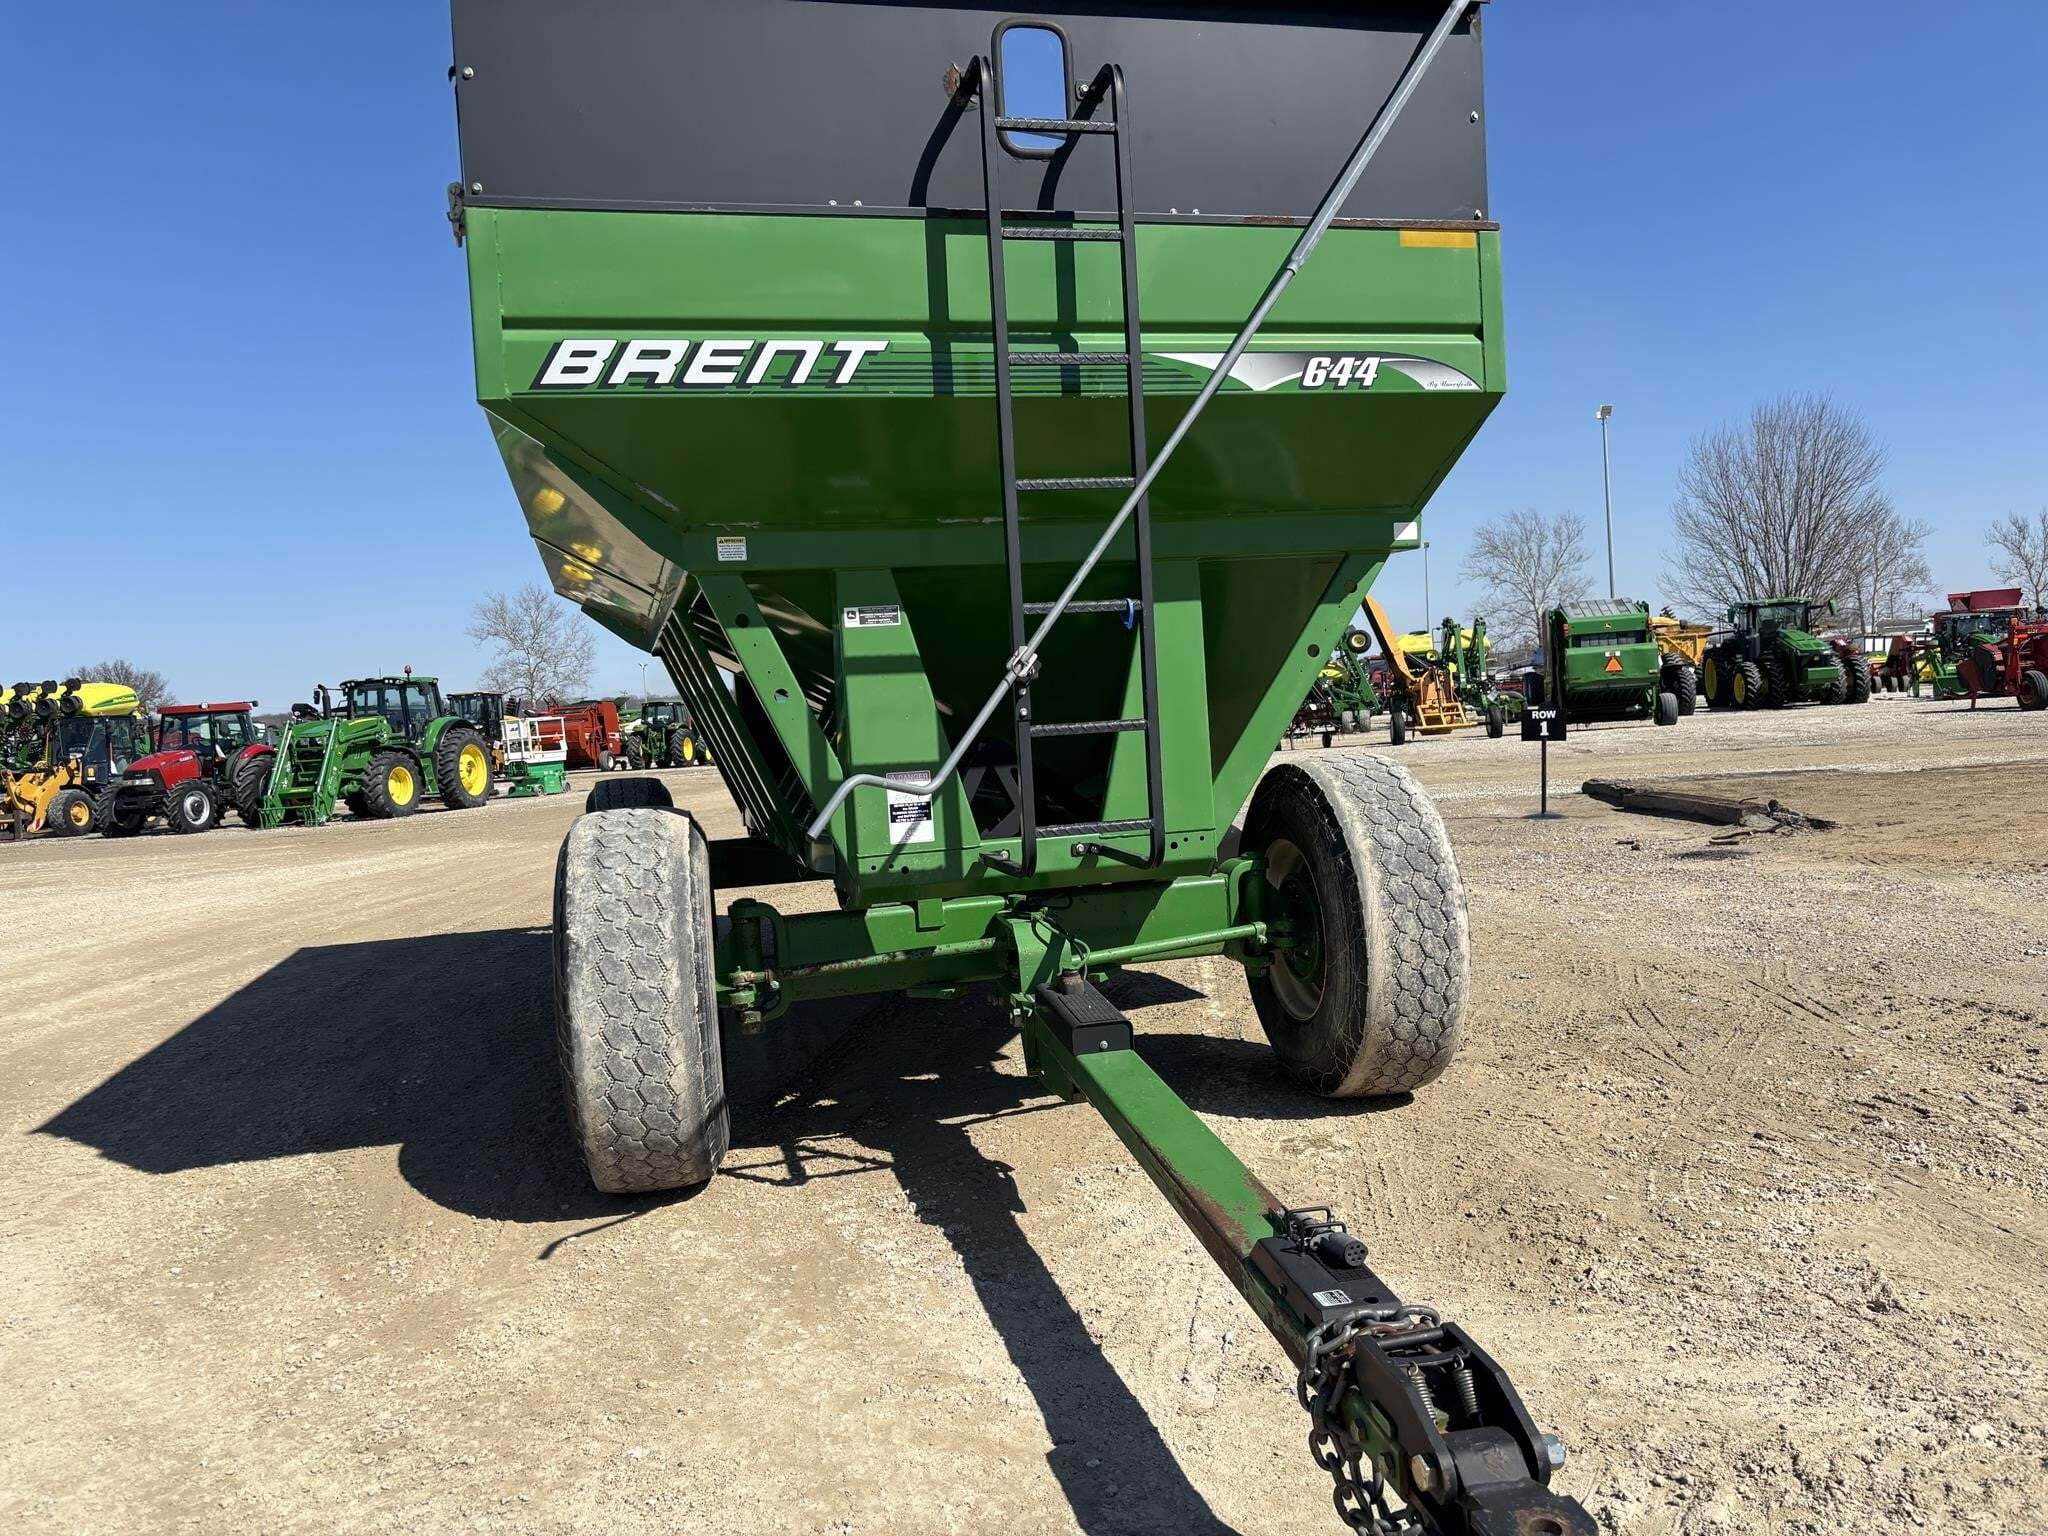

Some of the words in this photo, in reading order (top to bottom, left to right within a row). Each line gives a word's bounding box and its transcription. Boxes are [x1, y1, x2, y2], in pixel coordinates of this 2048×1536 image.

[531, 338, 890, 389] BRENT
[1301, 355, 1380, 389] 644
[1531, 710, 1556, 719] ROW
[1540, 720, 1549, 736] 1
[898, 773, 928, 781] DANGER
